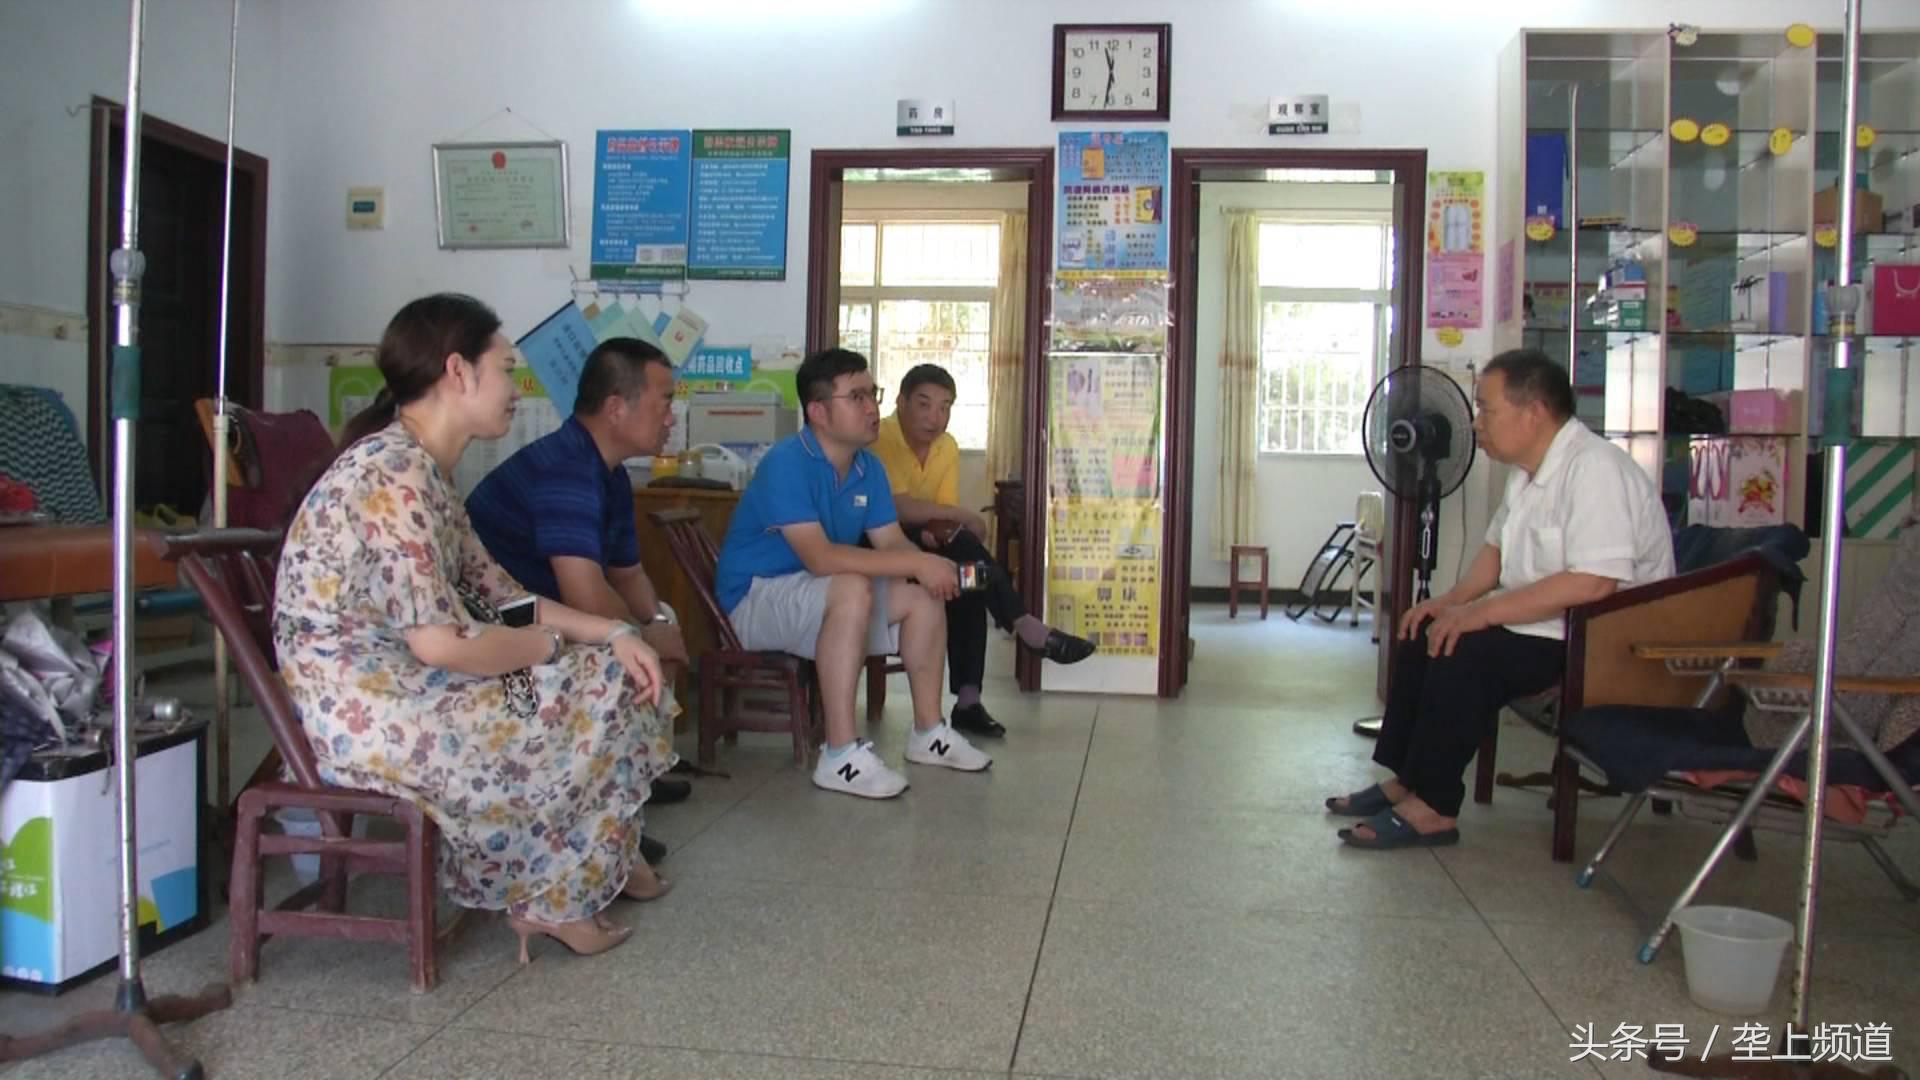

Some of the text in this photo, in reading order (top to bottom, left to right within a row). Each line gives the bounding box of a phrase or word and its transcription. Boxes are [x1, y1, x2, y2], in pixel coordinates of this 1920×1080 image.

[1089, 39, 1099, 50] 11
[1106, 39, 1120, 51] 12
[1128, 39, 1133, 50] 1
[1072, 47, 1085, 58] 10
[1143, 47, 1152, 58] 2
[1072, 67, 1082, 78] 9
[1142, 66, 1151, 78] 3
[1072, 87, 1081, 98] 8
[1142, 87, 1150, 97] 4
[1091, 95, 1098, 105] 7
[1124, 94, 1133, 105] 5
[929, 739, 951, 756] N
[837, 762, 861, 783] N
